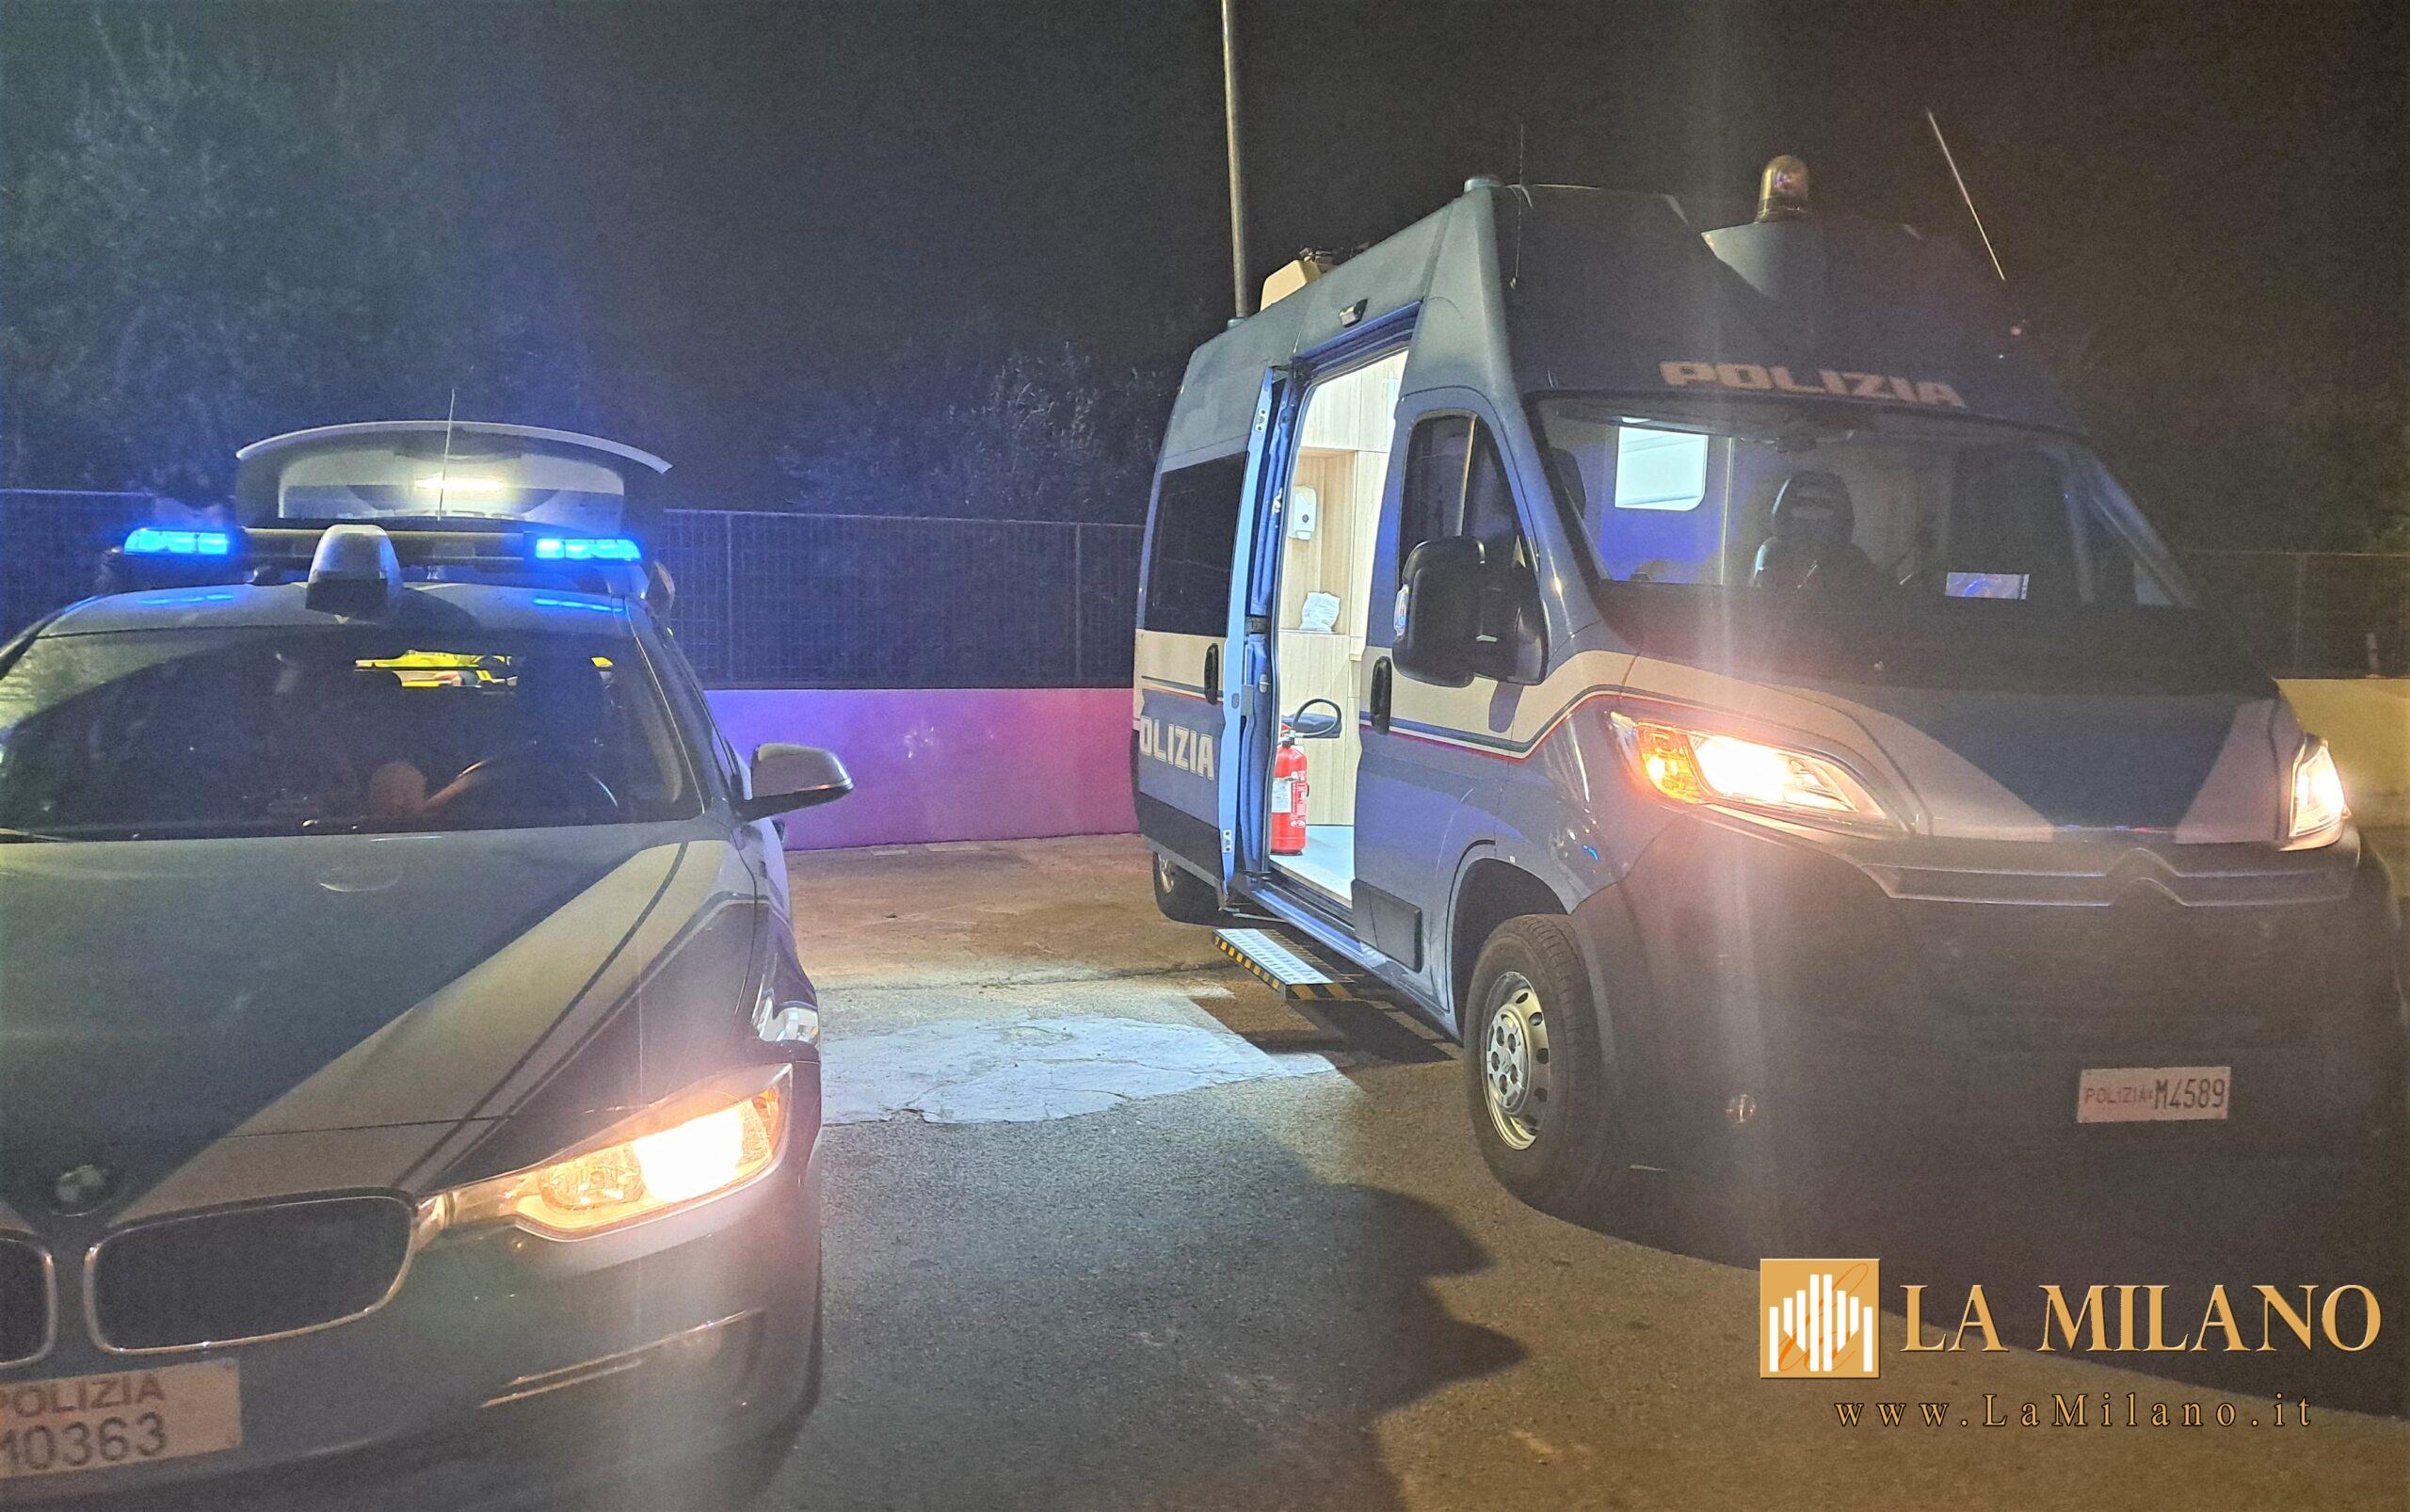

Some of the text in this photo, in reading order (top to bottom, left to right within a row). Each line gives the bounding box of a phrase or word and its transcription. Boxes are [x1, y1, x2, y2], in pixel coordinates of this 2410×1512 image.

[1659, 361, 1967, 408] POLIZIA
[2084, 1078, 2225, 1109] POLIZIA M4589
